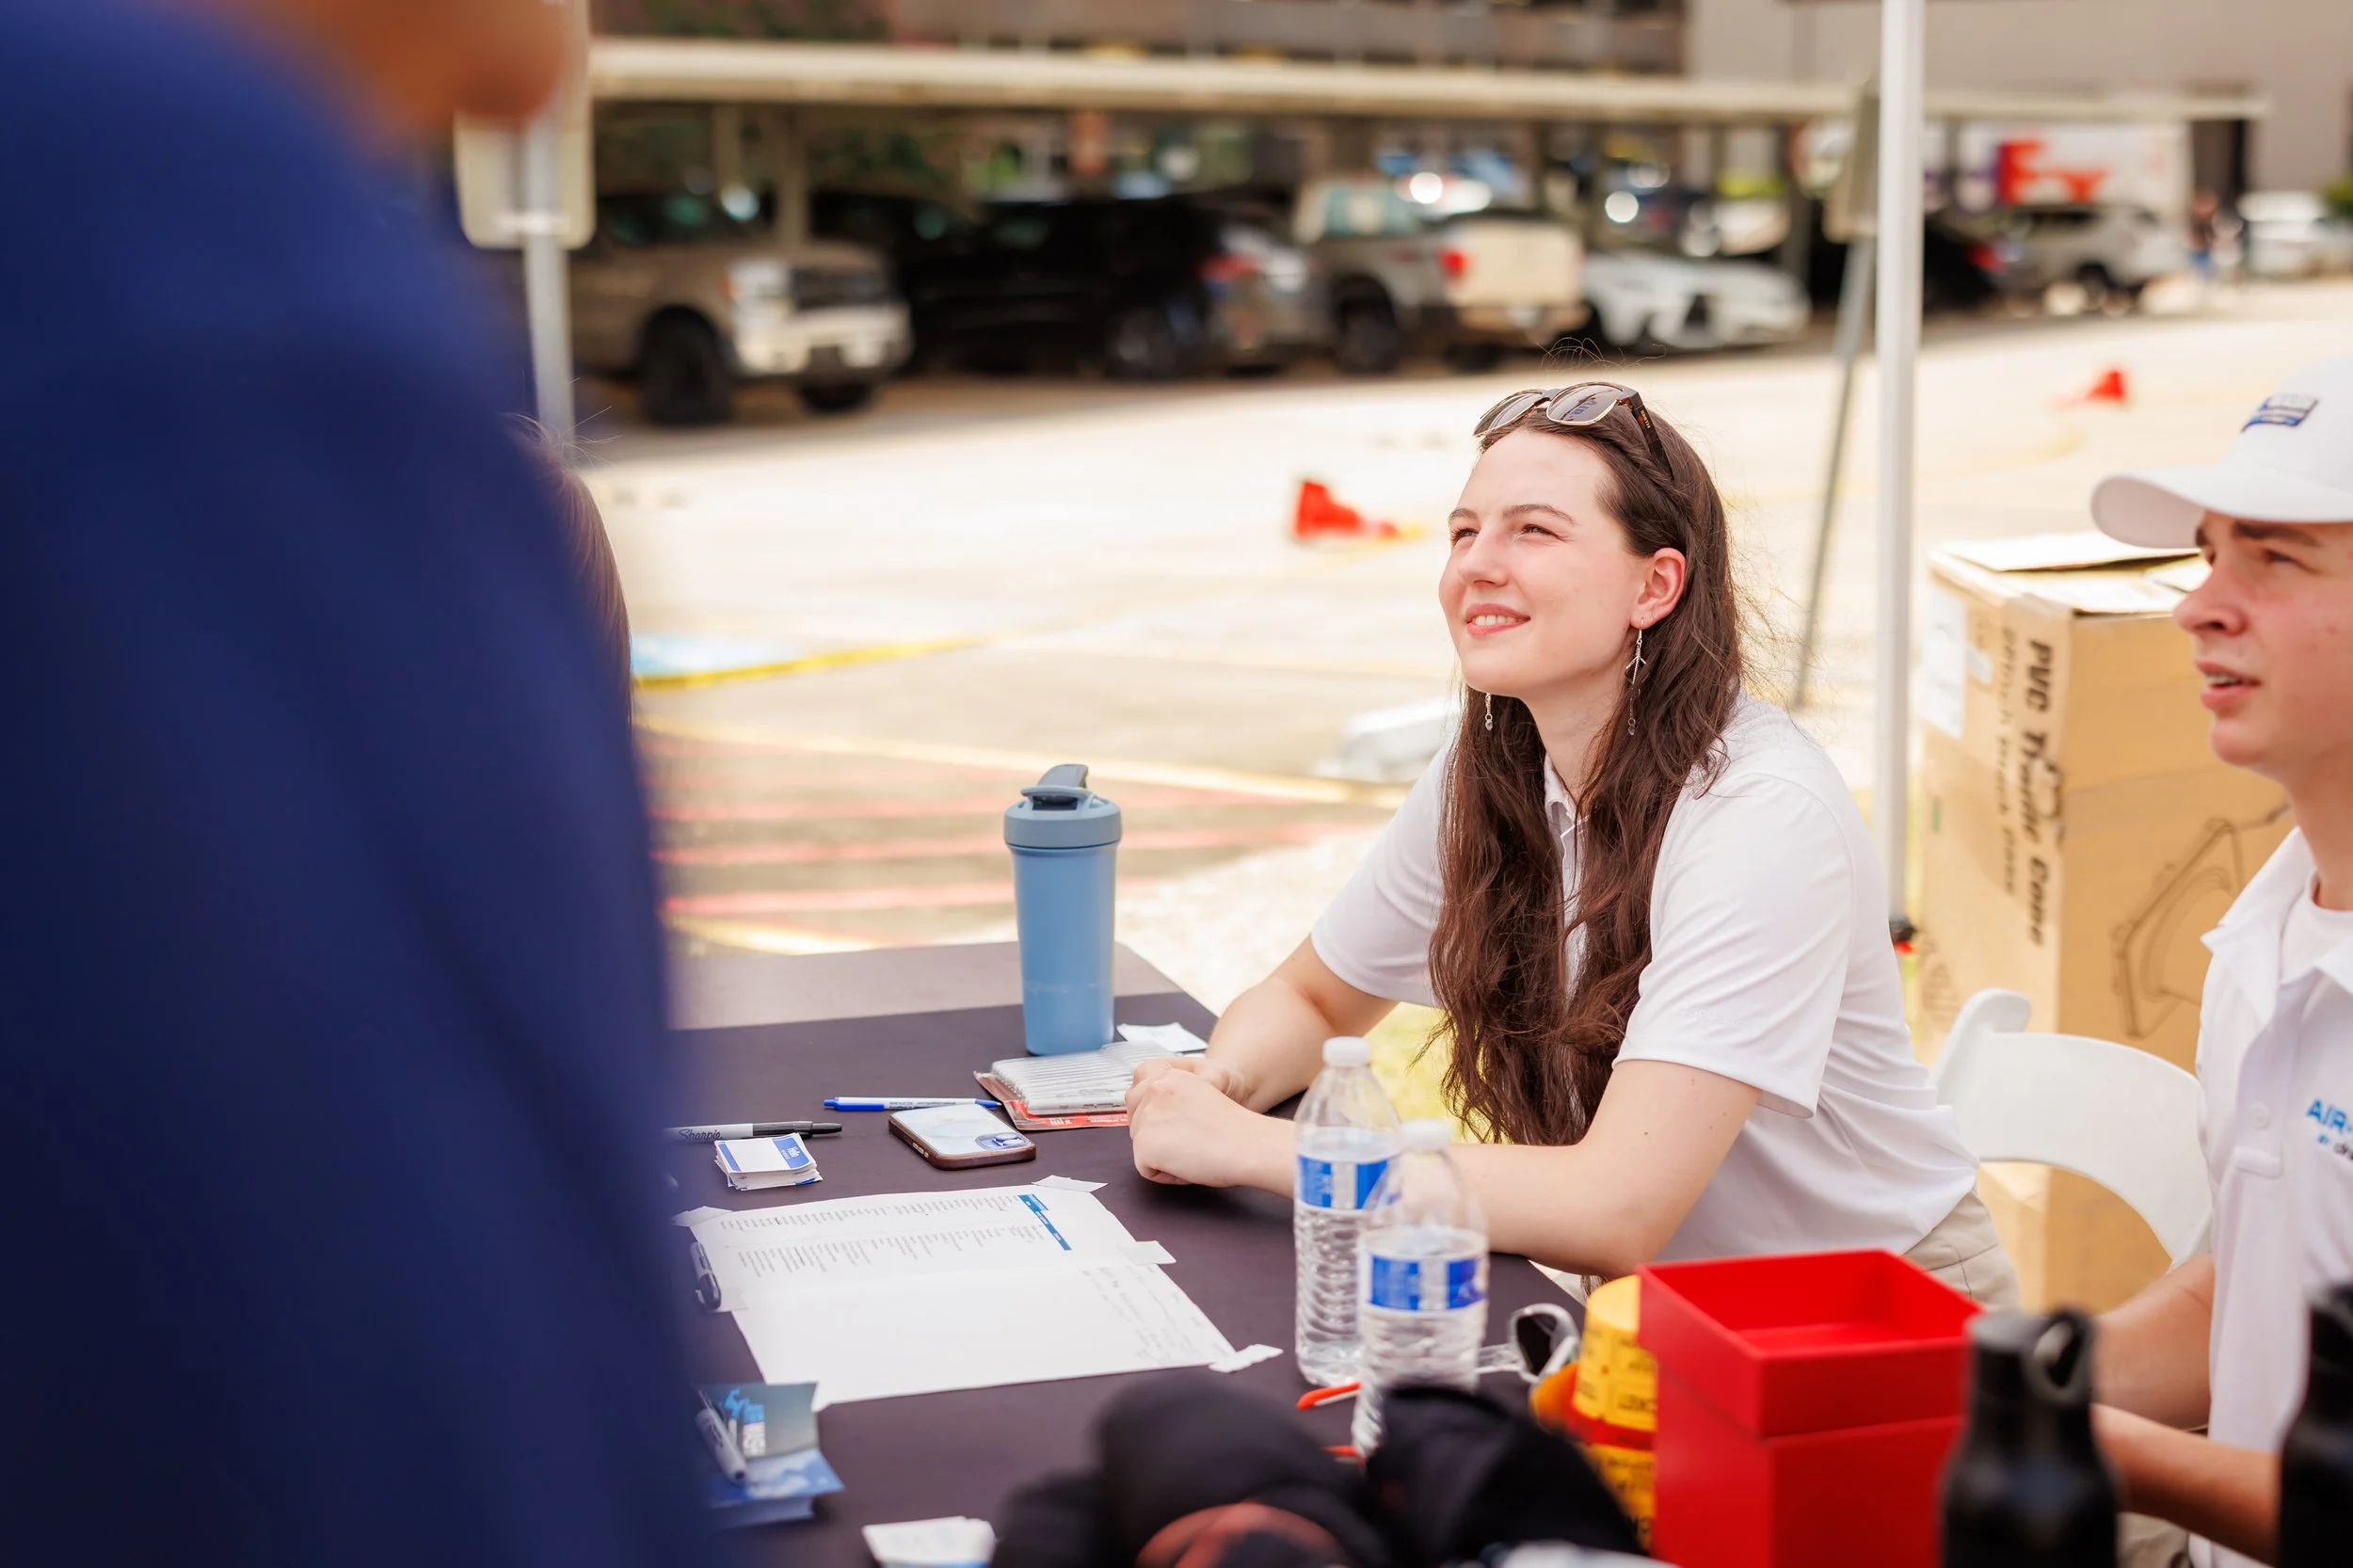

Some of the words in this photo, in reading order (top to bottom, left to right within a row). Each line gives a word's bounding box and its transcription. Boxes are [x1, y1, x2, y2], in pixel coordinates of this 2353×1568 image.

[2026, 639, 2053, 713] PVC
[2030, 856, 2048, 947] Cone
[678, 1128, 723, 1142] Sharpie
